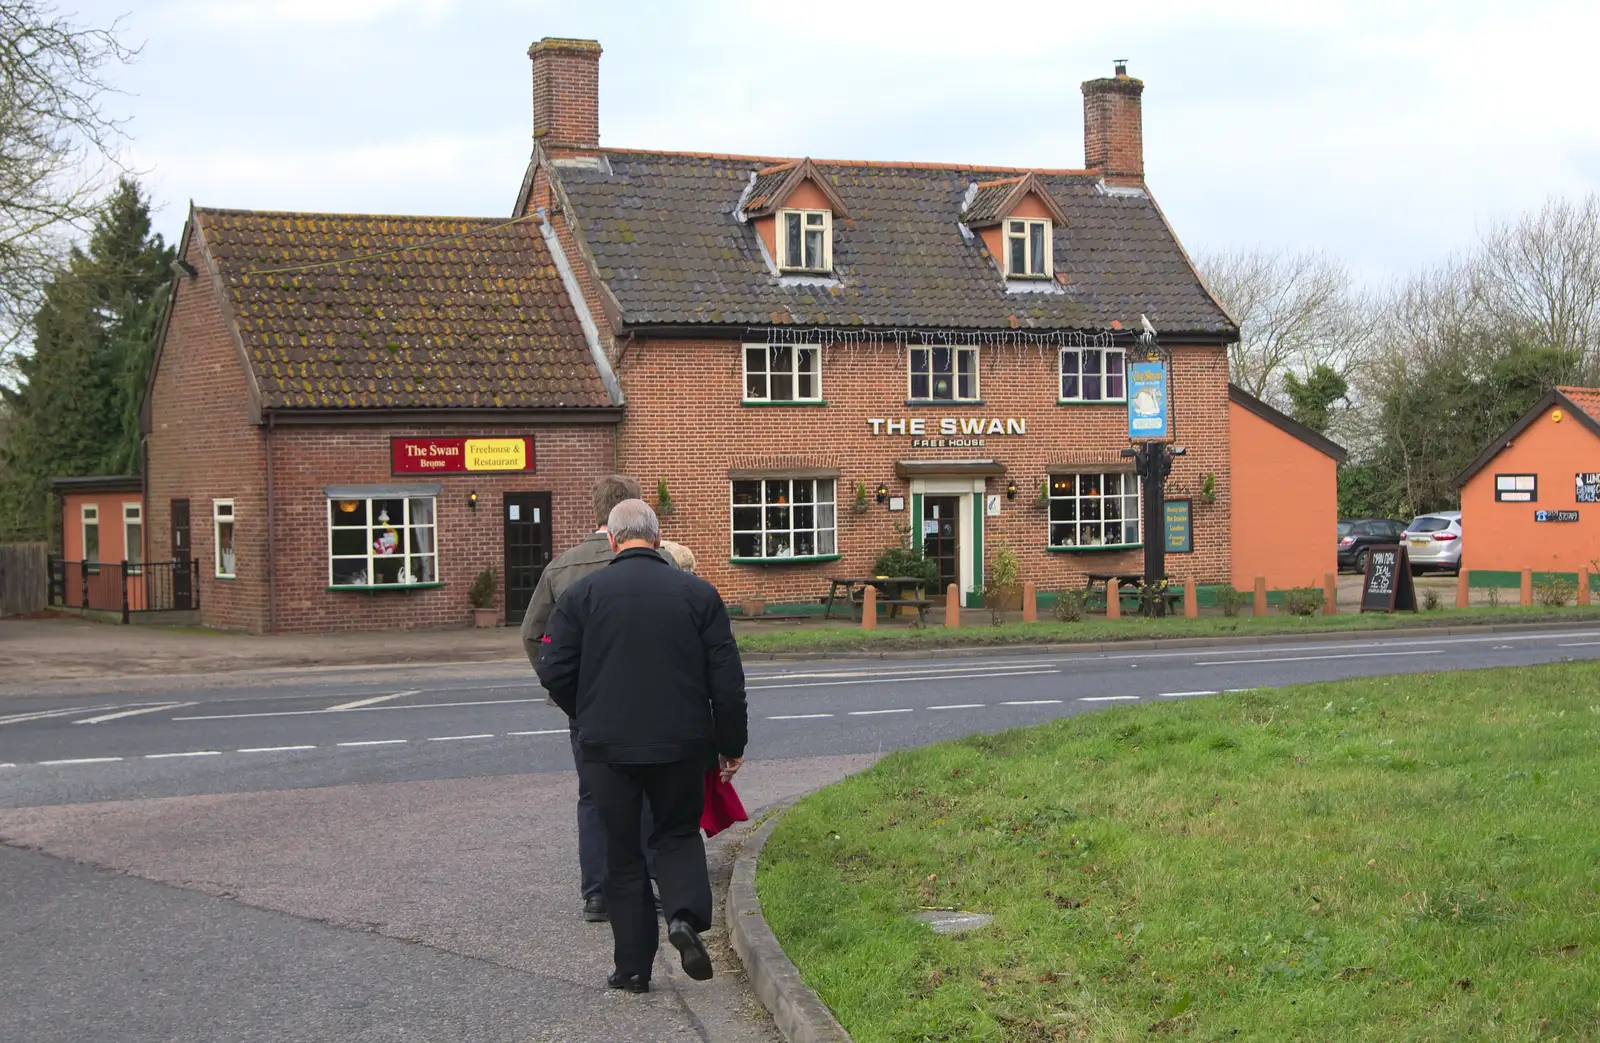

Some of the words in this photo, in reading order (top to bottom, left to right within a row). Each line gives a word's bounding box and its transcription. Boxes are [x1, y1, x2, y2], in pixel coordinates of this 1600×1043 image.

[867, 418, 926, 435] THE
[940, 418, 1026, 435] SWAN
[949, 439, 986, 447] HOUSE
[406, 444, 427, 456] The
[429, 444, 459, 456] Swan
[470, 445, 510, 454] Freehouse
[513, 443, 520, 453] &
[420, 459, 446, 468] Brome
[474, 457, 518, 466] Restaurant
